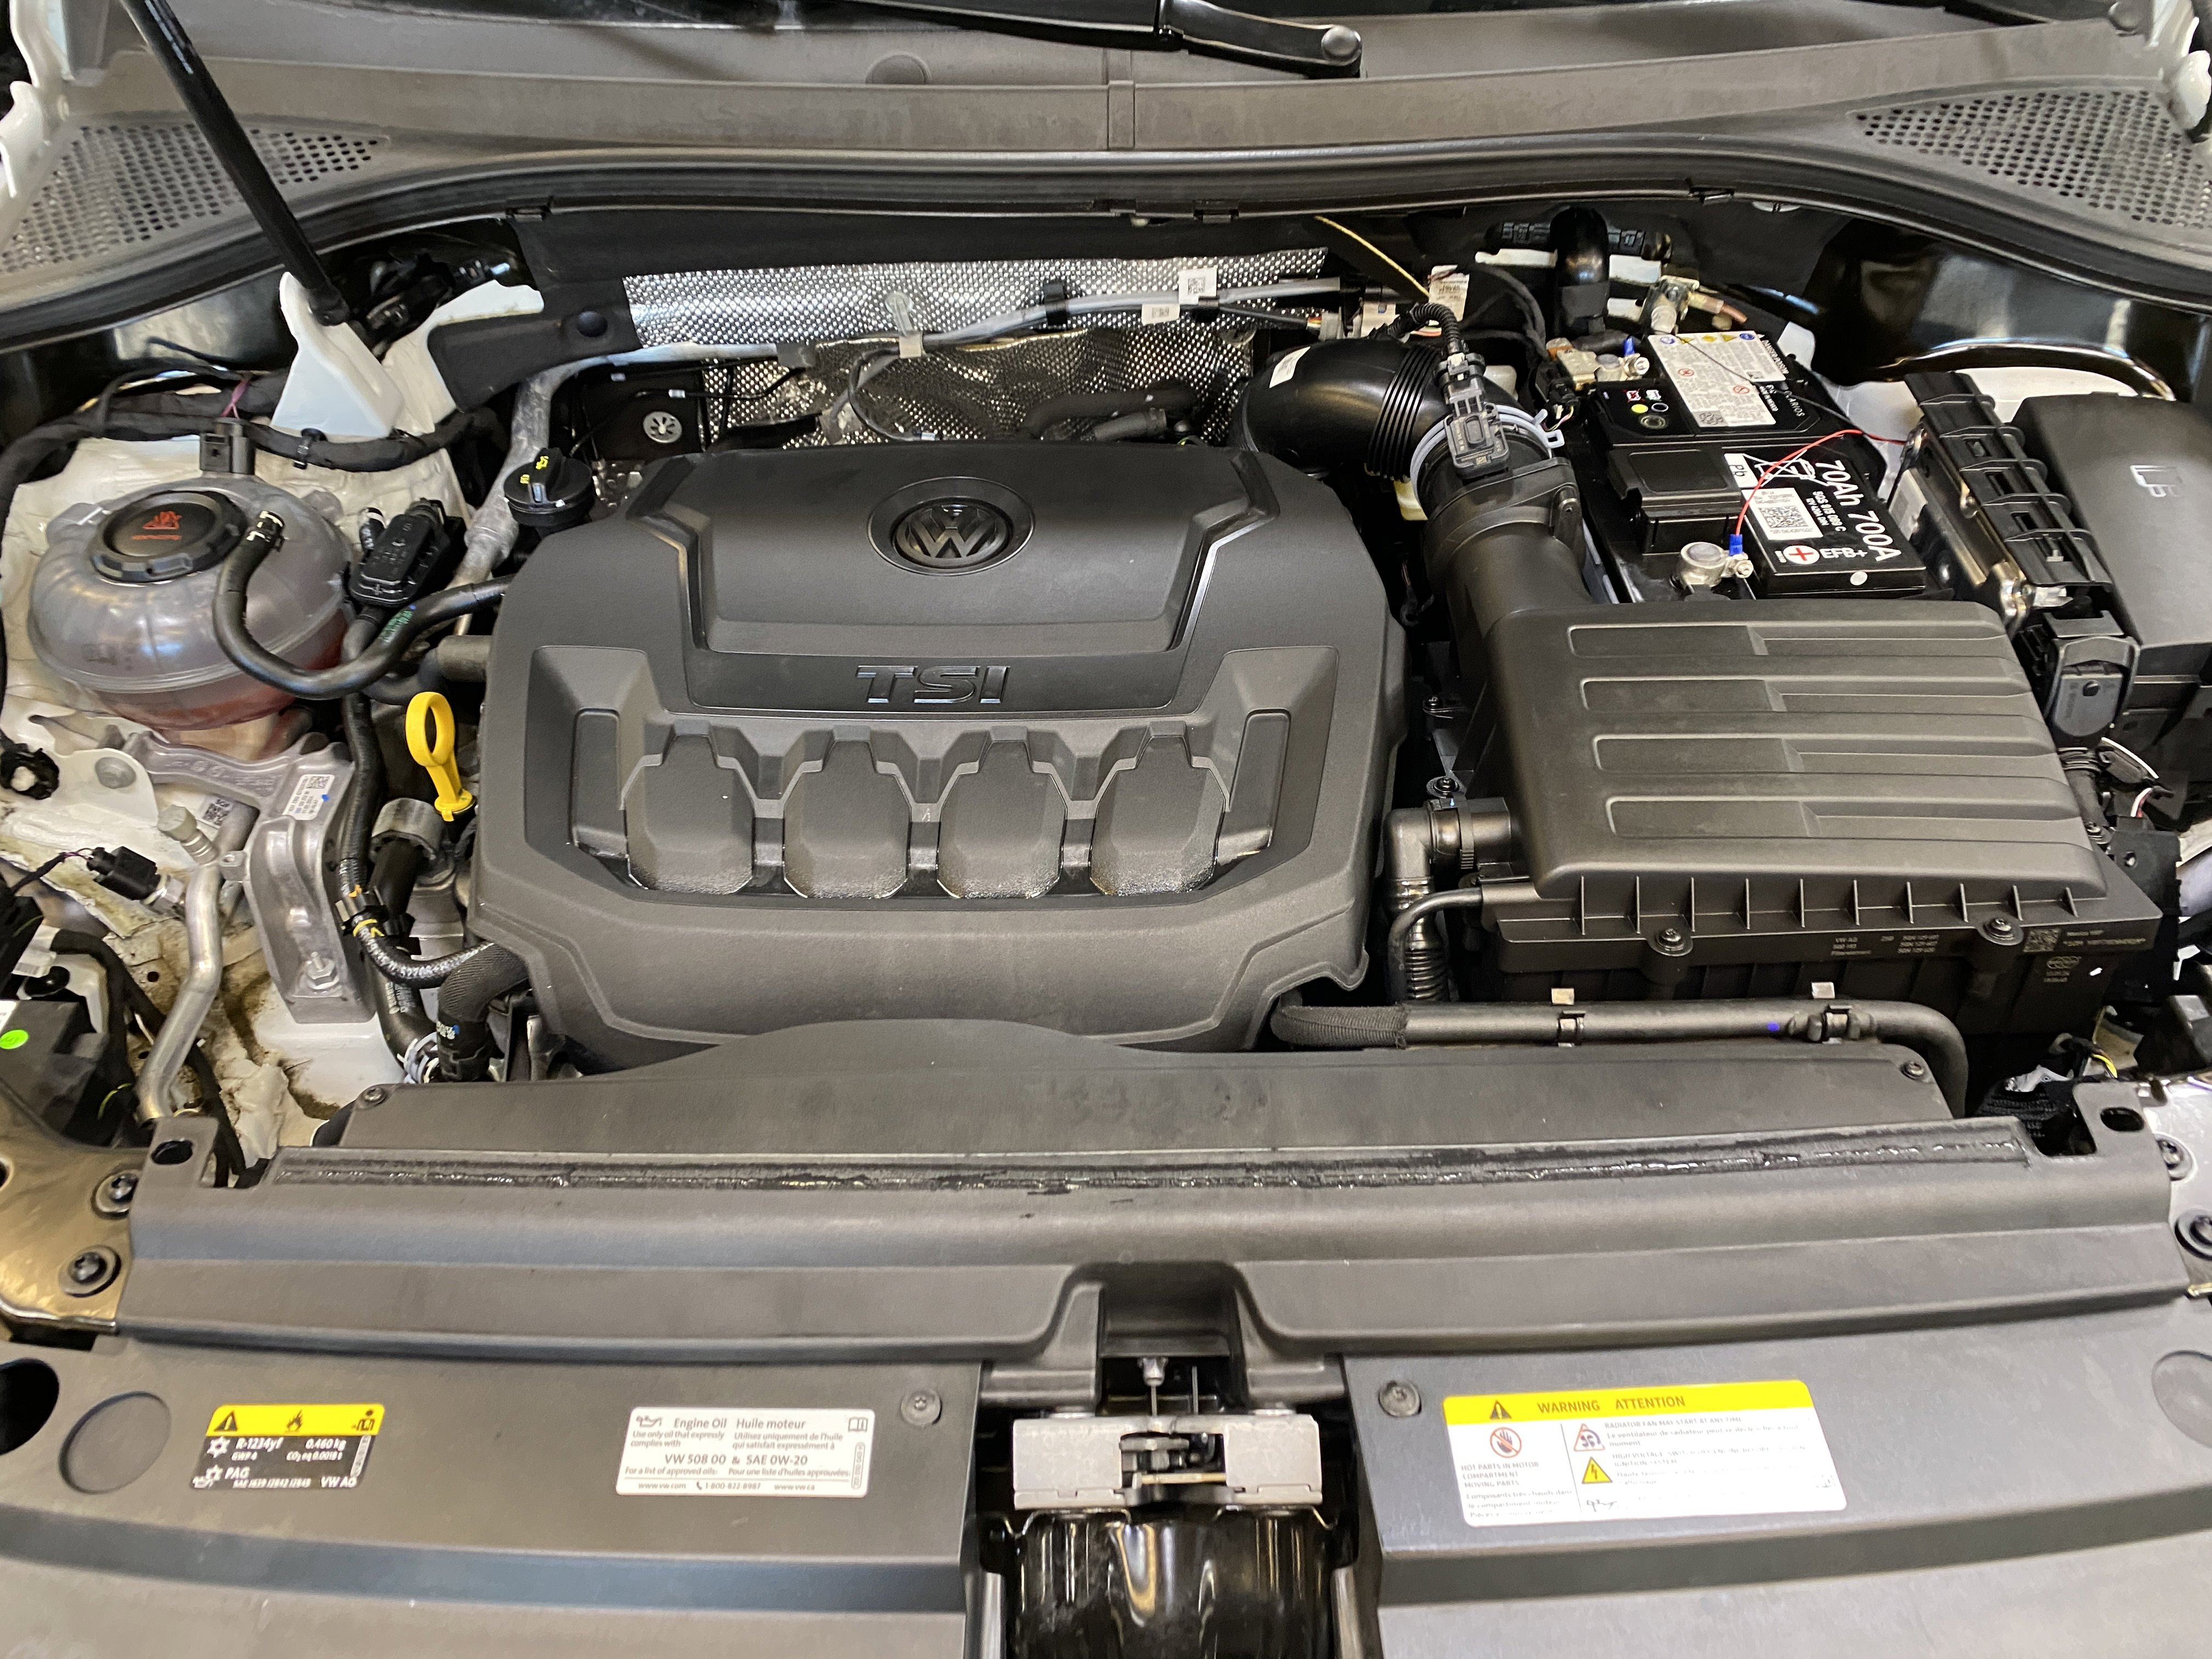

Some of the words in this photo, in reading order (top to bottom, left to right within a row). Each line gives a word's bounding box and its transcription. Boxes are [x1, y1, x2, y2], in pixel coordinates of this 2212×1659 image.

[1815, 460, 1864, 506] 70Ah
[897, 500, 1007, 566] VW
[1848, 510, 1901, 561] 700A
[1819, 548, 1868, 558] EFB+
[856, 665, 1011, 704] TSI
[1537, 1400, 1600, 1414] WARNING
[1615, 1396, 1685, 1409] ATTENTION
[674, 1418, 709, 1431] Engine
[712, 1418, 727, 1429] Oil
[736, 1418, 764, 1429] Huile
[766, 1419, 806, 1430] moteur
[647, 1430, 663, 1440] only
[675, 1430, 689, 1438] that
[691, 1431, 725, 1441] expressly
[763, 1432, 808, 1442] uniquement
[631, 1440, 663, 1448] complies
[732, 1441, 744, 1451] qui
[746, 1441, 775, 1449] satisfait
[665, 1453, 685, 1464] VW
[687, 1454, 708, 1464] 508
[711, 1454, 726, 1464] 00
[731, 1455, 740, 1465] &
[746, 1454, 768, 1465] SAE
[770, 1455, 808, 1466] 0W-20
[224, 1466, 250, 1479] PAG
[625, 1466, 637, 1475] For
[645, 1466, 656, 1475] list
[657, 1466, 666, 1475] of
[667, 1467, 702, 1478] approved
[729, 1468, 745, 1476] Pour
[762, 1468, 777, 1476] liste
[320, 1476, 338, 1488] VW
[340, 1476, 357, 1488] AG
